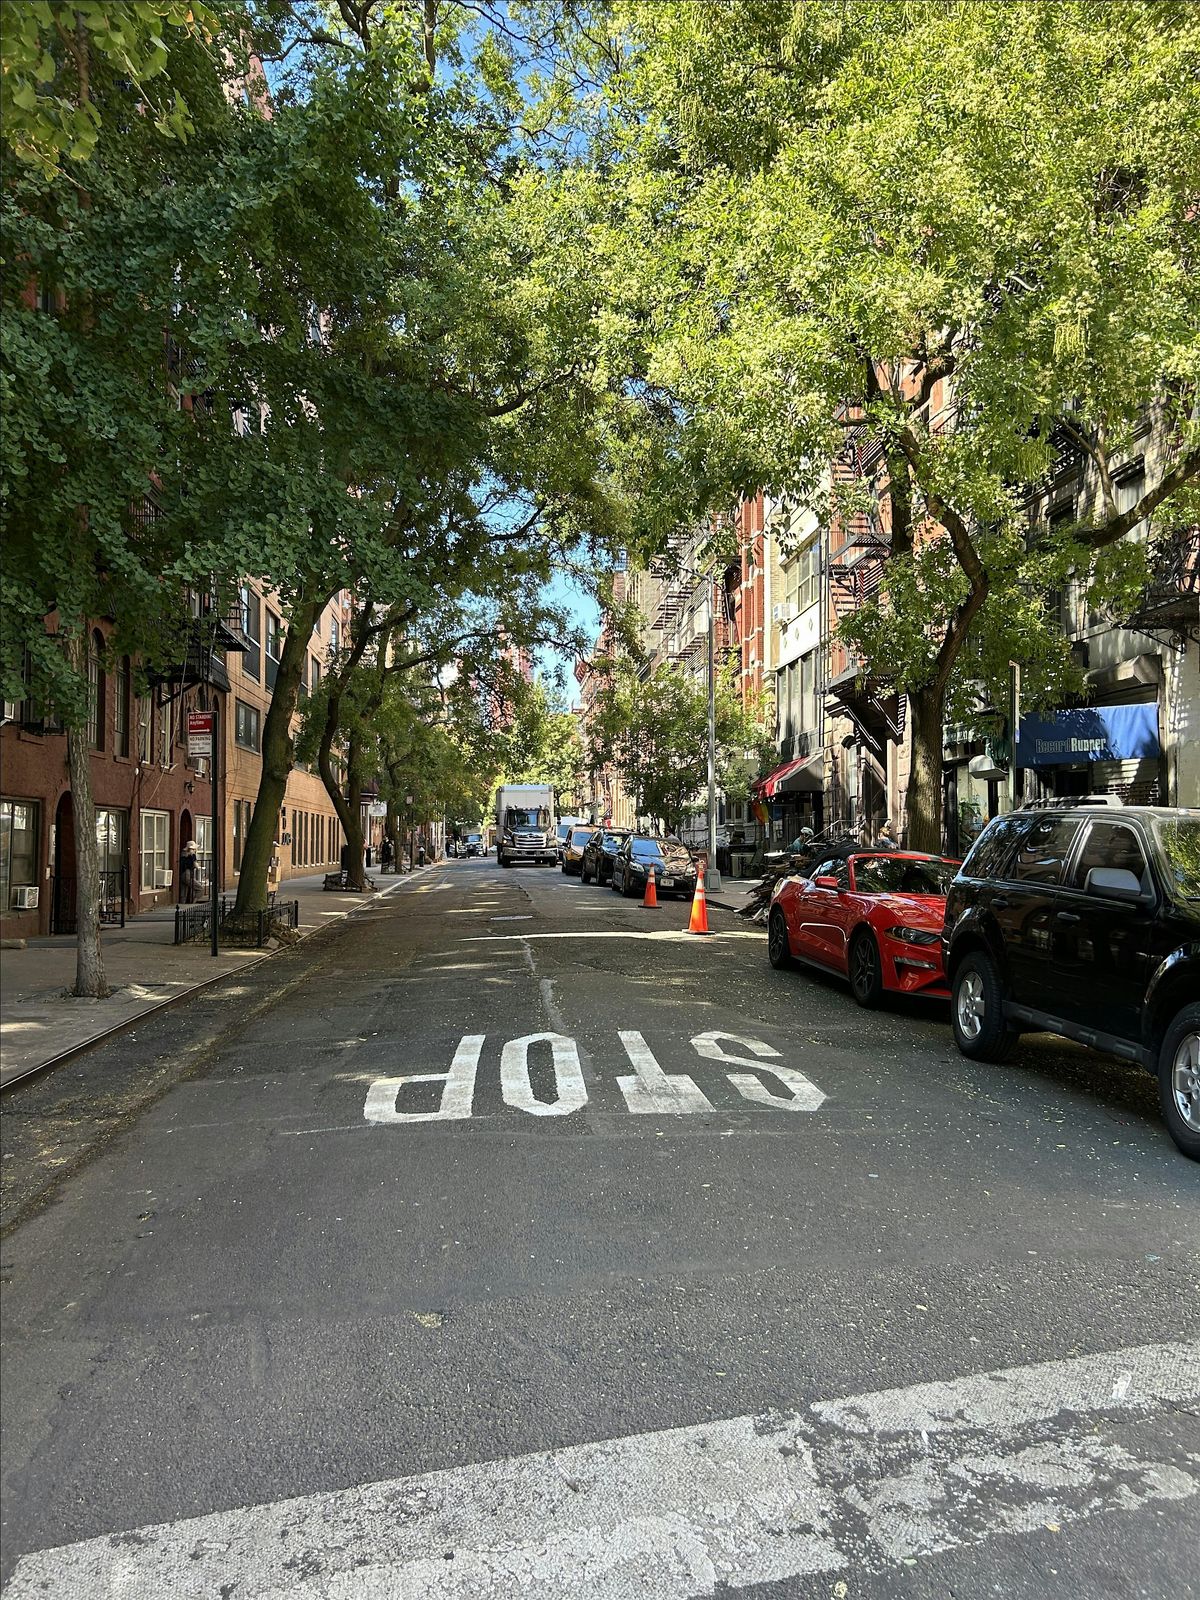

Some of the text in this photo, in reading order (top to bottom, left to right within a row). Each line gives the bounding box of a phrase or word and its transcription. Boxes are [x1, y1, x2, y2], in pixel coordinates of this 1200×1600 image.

[1035, 737, 1107, 753] Record Runner
[363, 1030, 828, 1123] STOP
